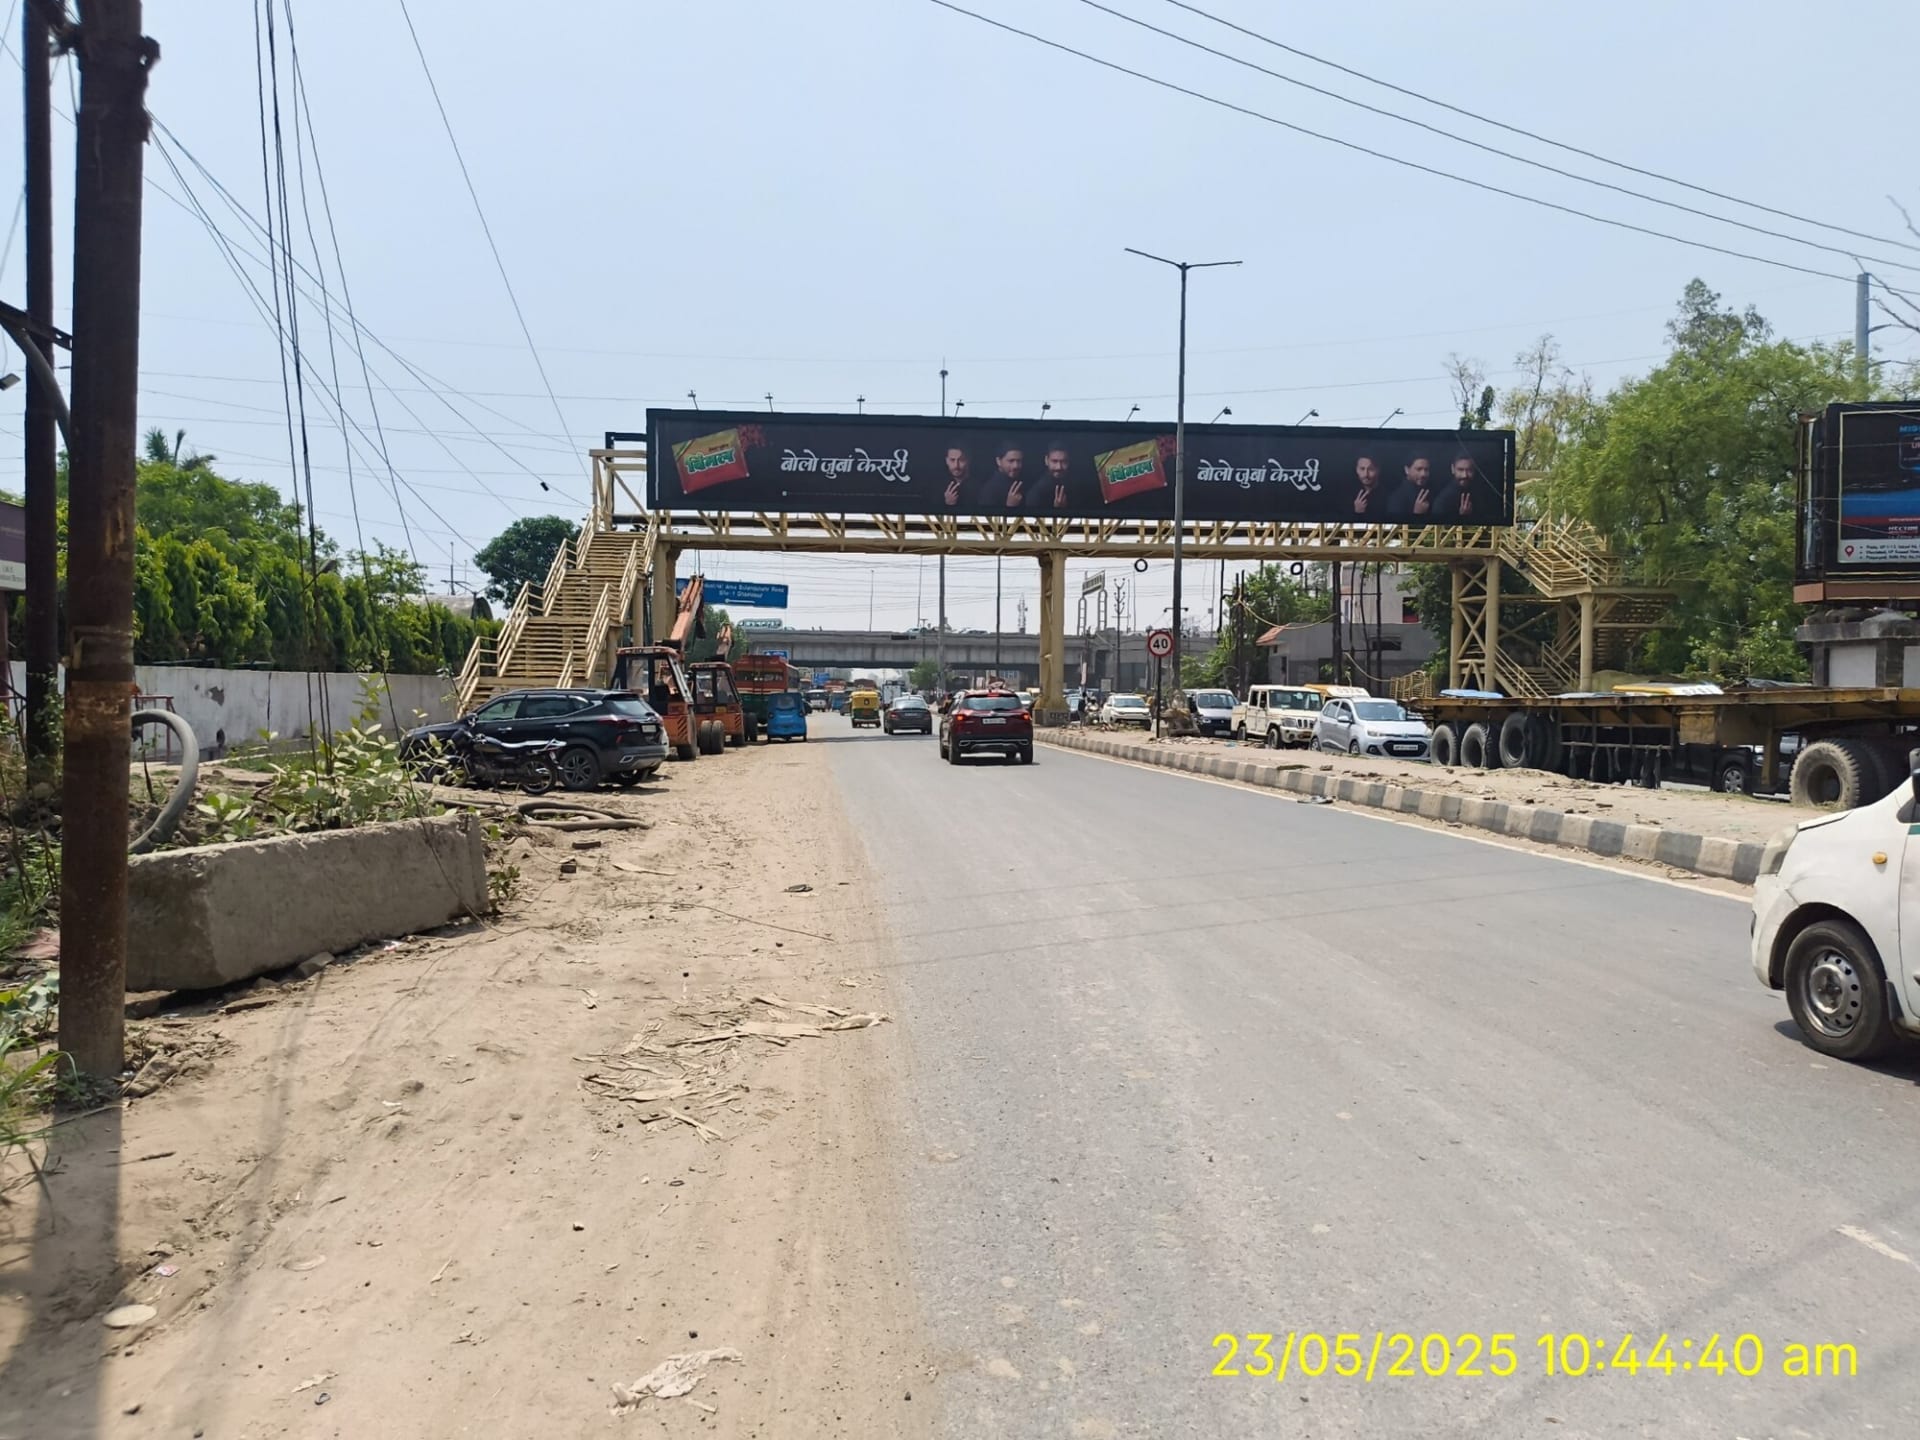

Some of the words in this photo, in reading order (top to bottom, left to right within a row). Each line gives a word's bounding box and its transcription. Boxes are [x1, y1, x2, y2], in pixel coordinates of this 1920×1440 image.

[780, 448, 820, 472] बोलो
[854, 447, 911, 482] केसरी
[1197, 459, 1234, 482] बोलो
[1268, 458, 1322, 491] केसरी
[1153, 638, 1168, 649] 40
